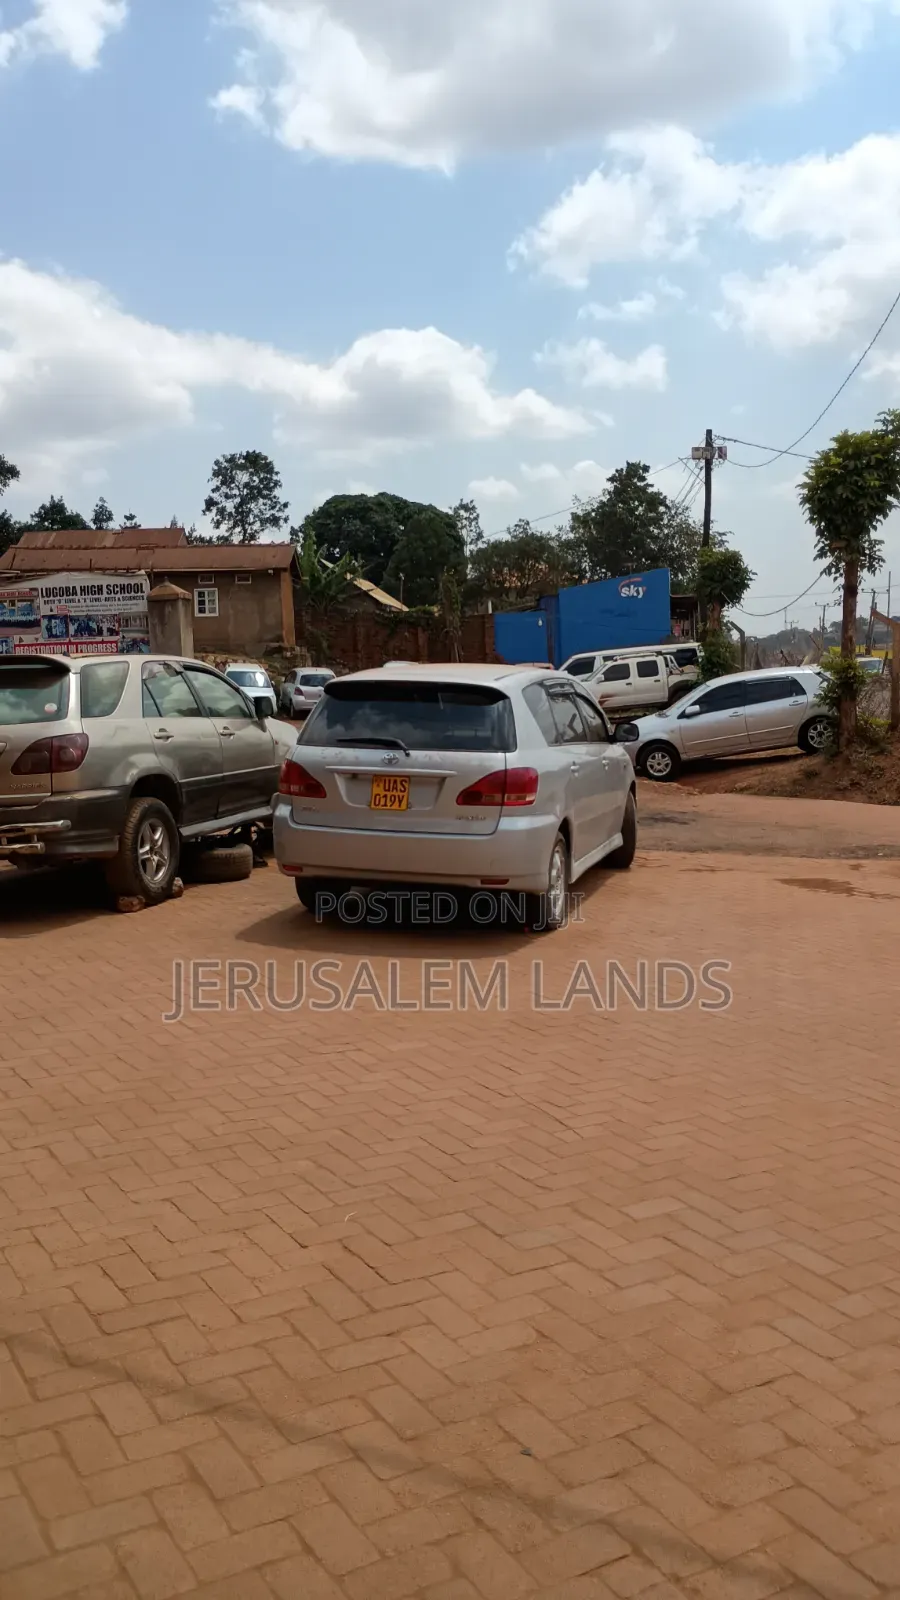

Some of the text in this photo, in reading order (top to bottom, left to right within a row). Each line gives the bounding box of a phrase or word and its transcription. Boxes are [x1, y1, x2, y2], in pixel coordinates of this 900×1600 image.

[41, 583, 145, 598] LUGOBA HIGH SCHOOL
[621, 585, 646, 599] sky
[15, 643, 117, 655] REGISTRATION IN PROGRESS
[383, 778, 408, 793] UAS
[373, 793, 405, 808] 019Y
